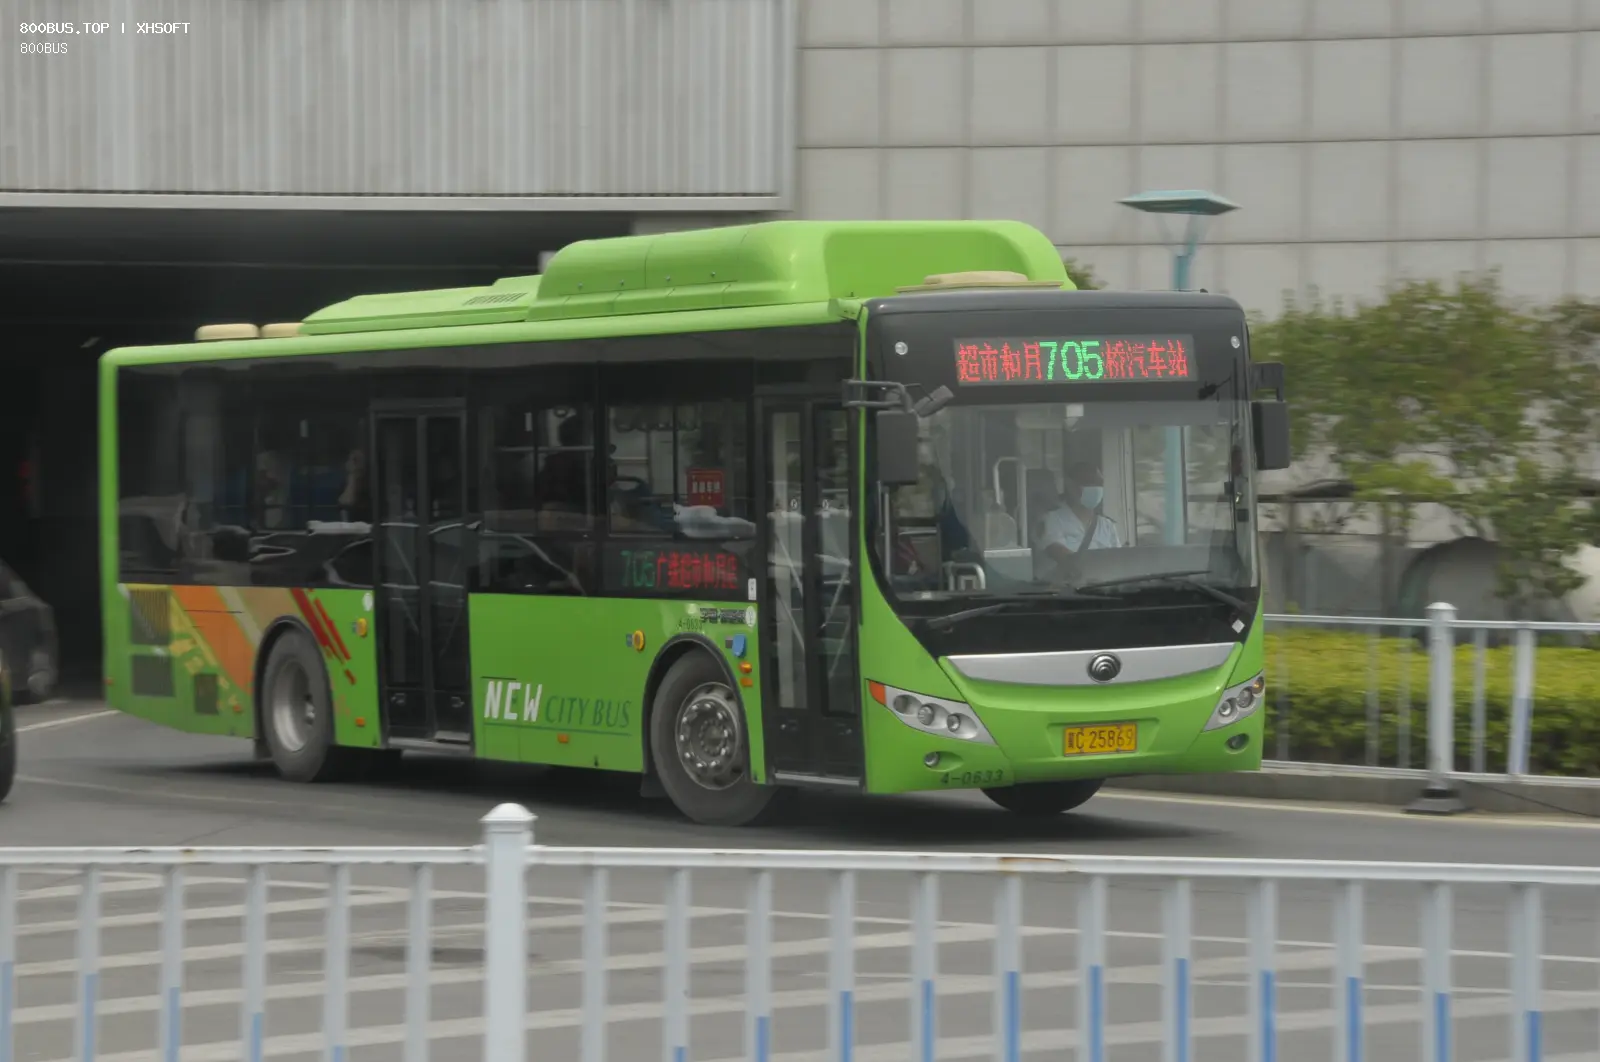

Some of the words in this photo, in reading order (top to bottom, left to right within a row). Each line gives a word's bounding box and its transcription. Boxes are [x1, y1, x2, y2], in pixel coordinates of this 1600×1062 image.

[484, 681, 543, 722] NEW
[545, 695, 591, 725] CITY
[592, 697, 632, 728] BUS
[940, 769, 1004, 786] 4-0633
